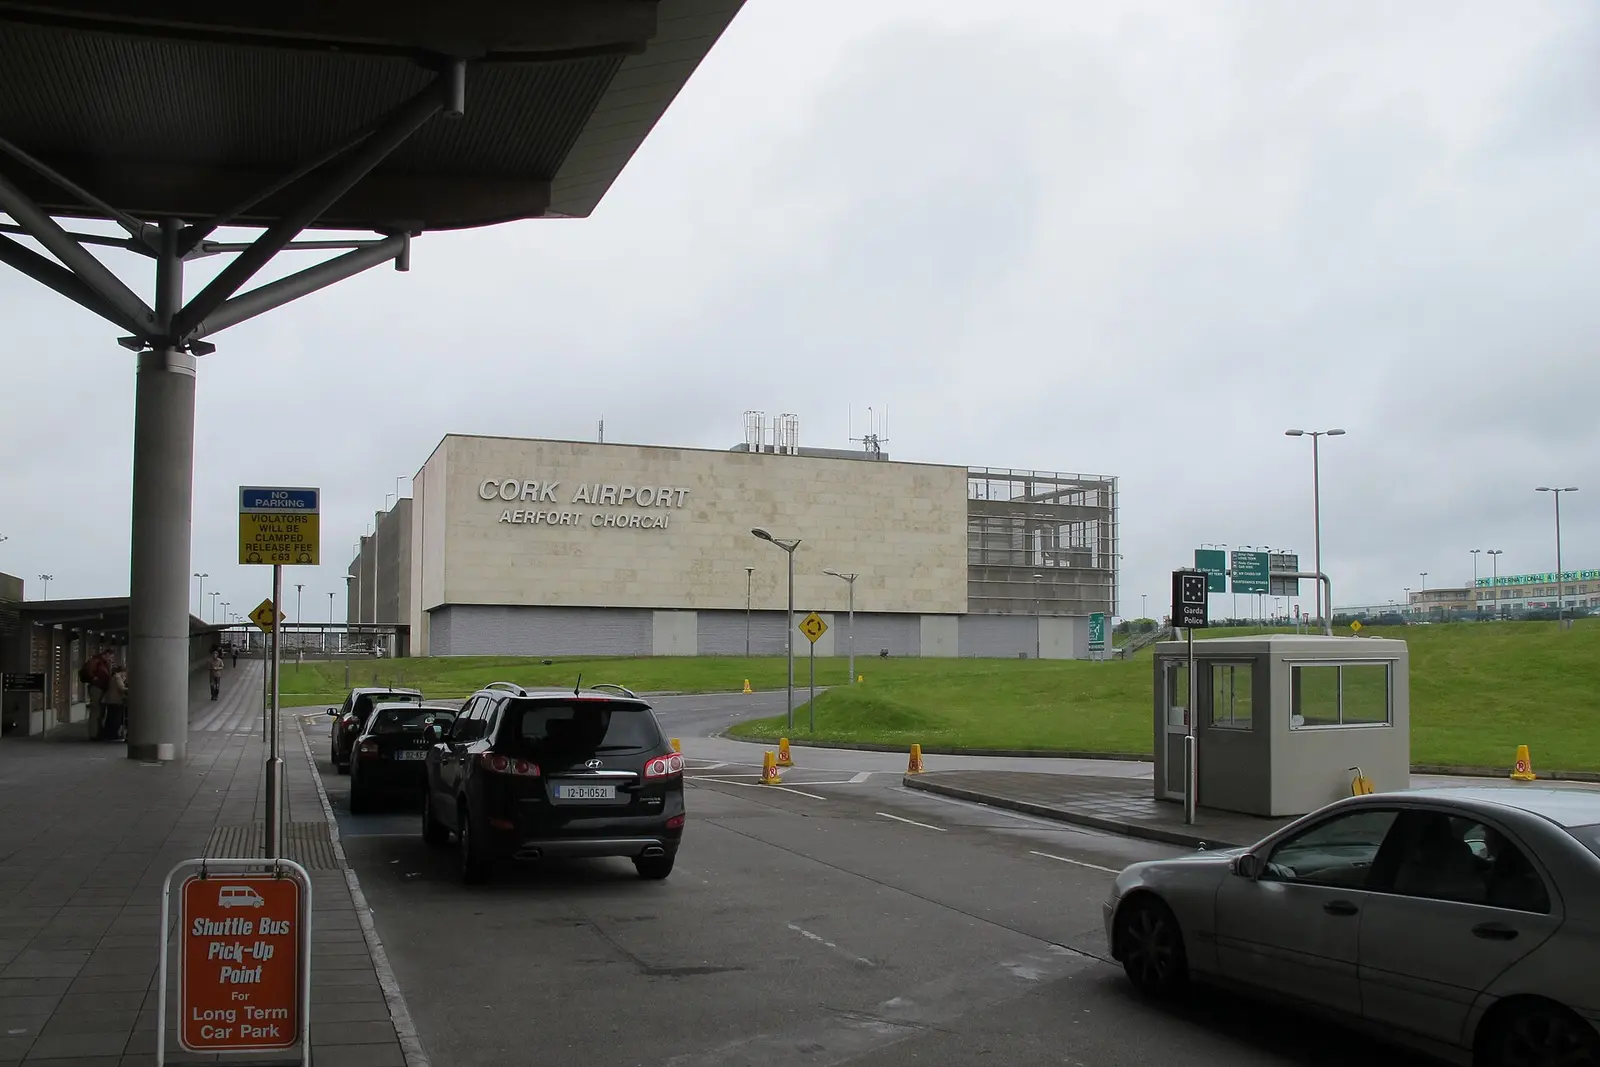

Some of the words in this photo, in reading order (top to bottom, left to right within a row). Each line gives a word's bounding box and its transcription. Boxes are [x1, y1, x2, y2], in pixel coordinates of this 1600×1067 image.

[271, 491, 288, 499] NO
[478, 478, 560, 503] CORK
[572, 483, 690, 508] AIRPORT
[255, 499, 304, 508] PARKING
[252, 515, 308, 524] VIOLATORS
[499, 509, 583, 526] AERFORT
[591, 512, 671, 529] CHORCAÍ
[1494, 575, 1544, 584] NTERNATIONAL
[567, 788, 608, 798] 12-D-10521
[192, 917, 252, 936] Shuttle
[258, 917, 290, 935] Bus
[208, 941, 274, 963] Pick-Up
[220, 966, 262, 984] Point
[232, 992, 250, 1000] For
[193, 1006, 236, 1024] Long
[244, 1006, 288, 1020] Term
[200, 1024, 233, 1039] Car
[240, 1024, 280, 1038] Park
